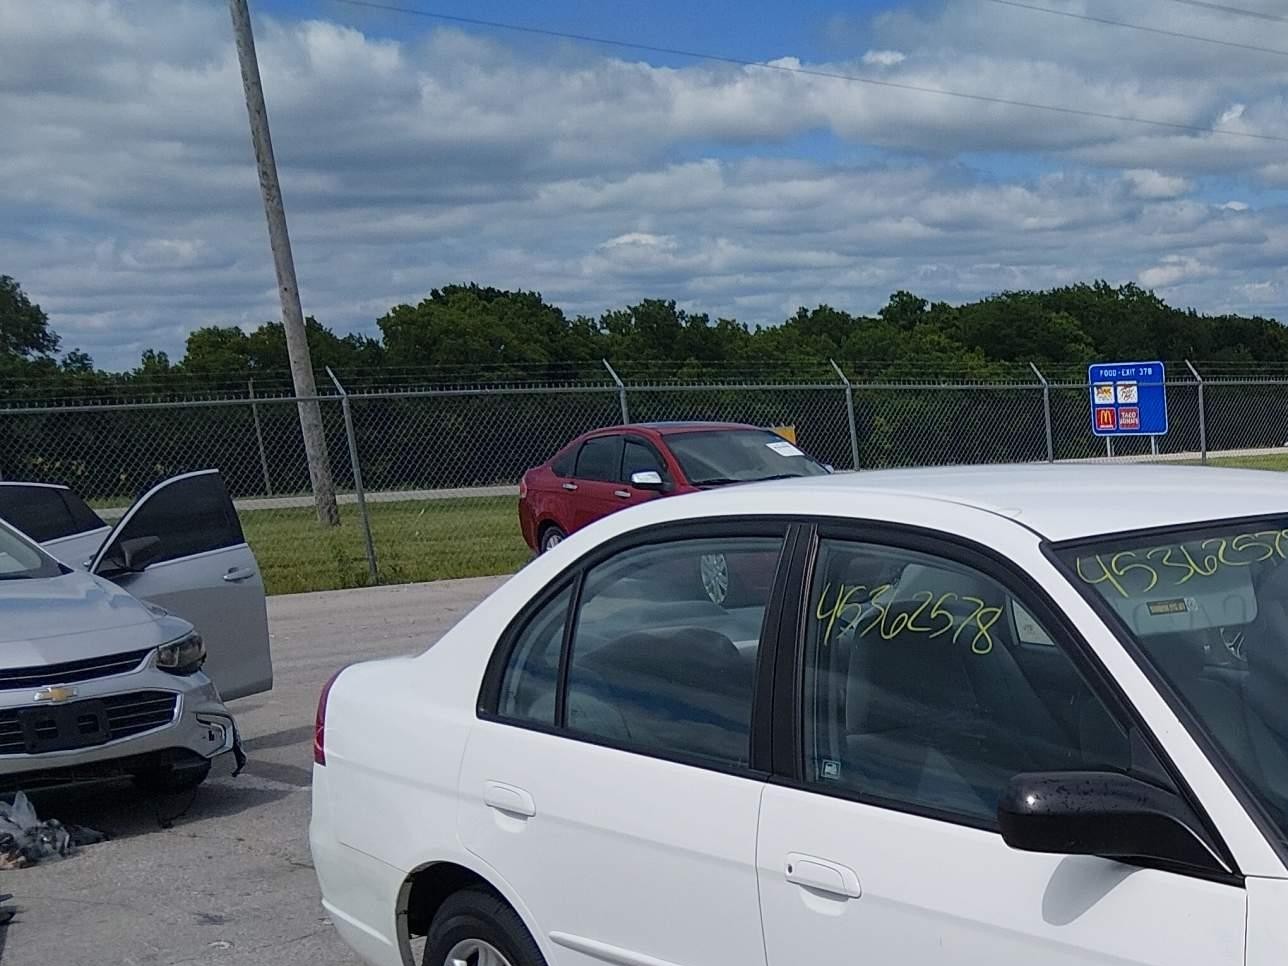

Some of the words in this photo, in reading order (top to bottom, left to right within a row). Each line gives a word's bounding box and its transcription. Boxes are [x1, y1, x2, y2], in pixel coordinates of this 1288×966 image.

[1100, 369, 1116, 377] FOOD
[1121, 368, 1135, 376] EXIT
[816, 582, 1003, 654] 45362578
